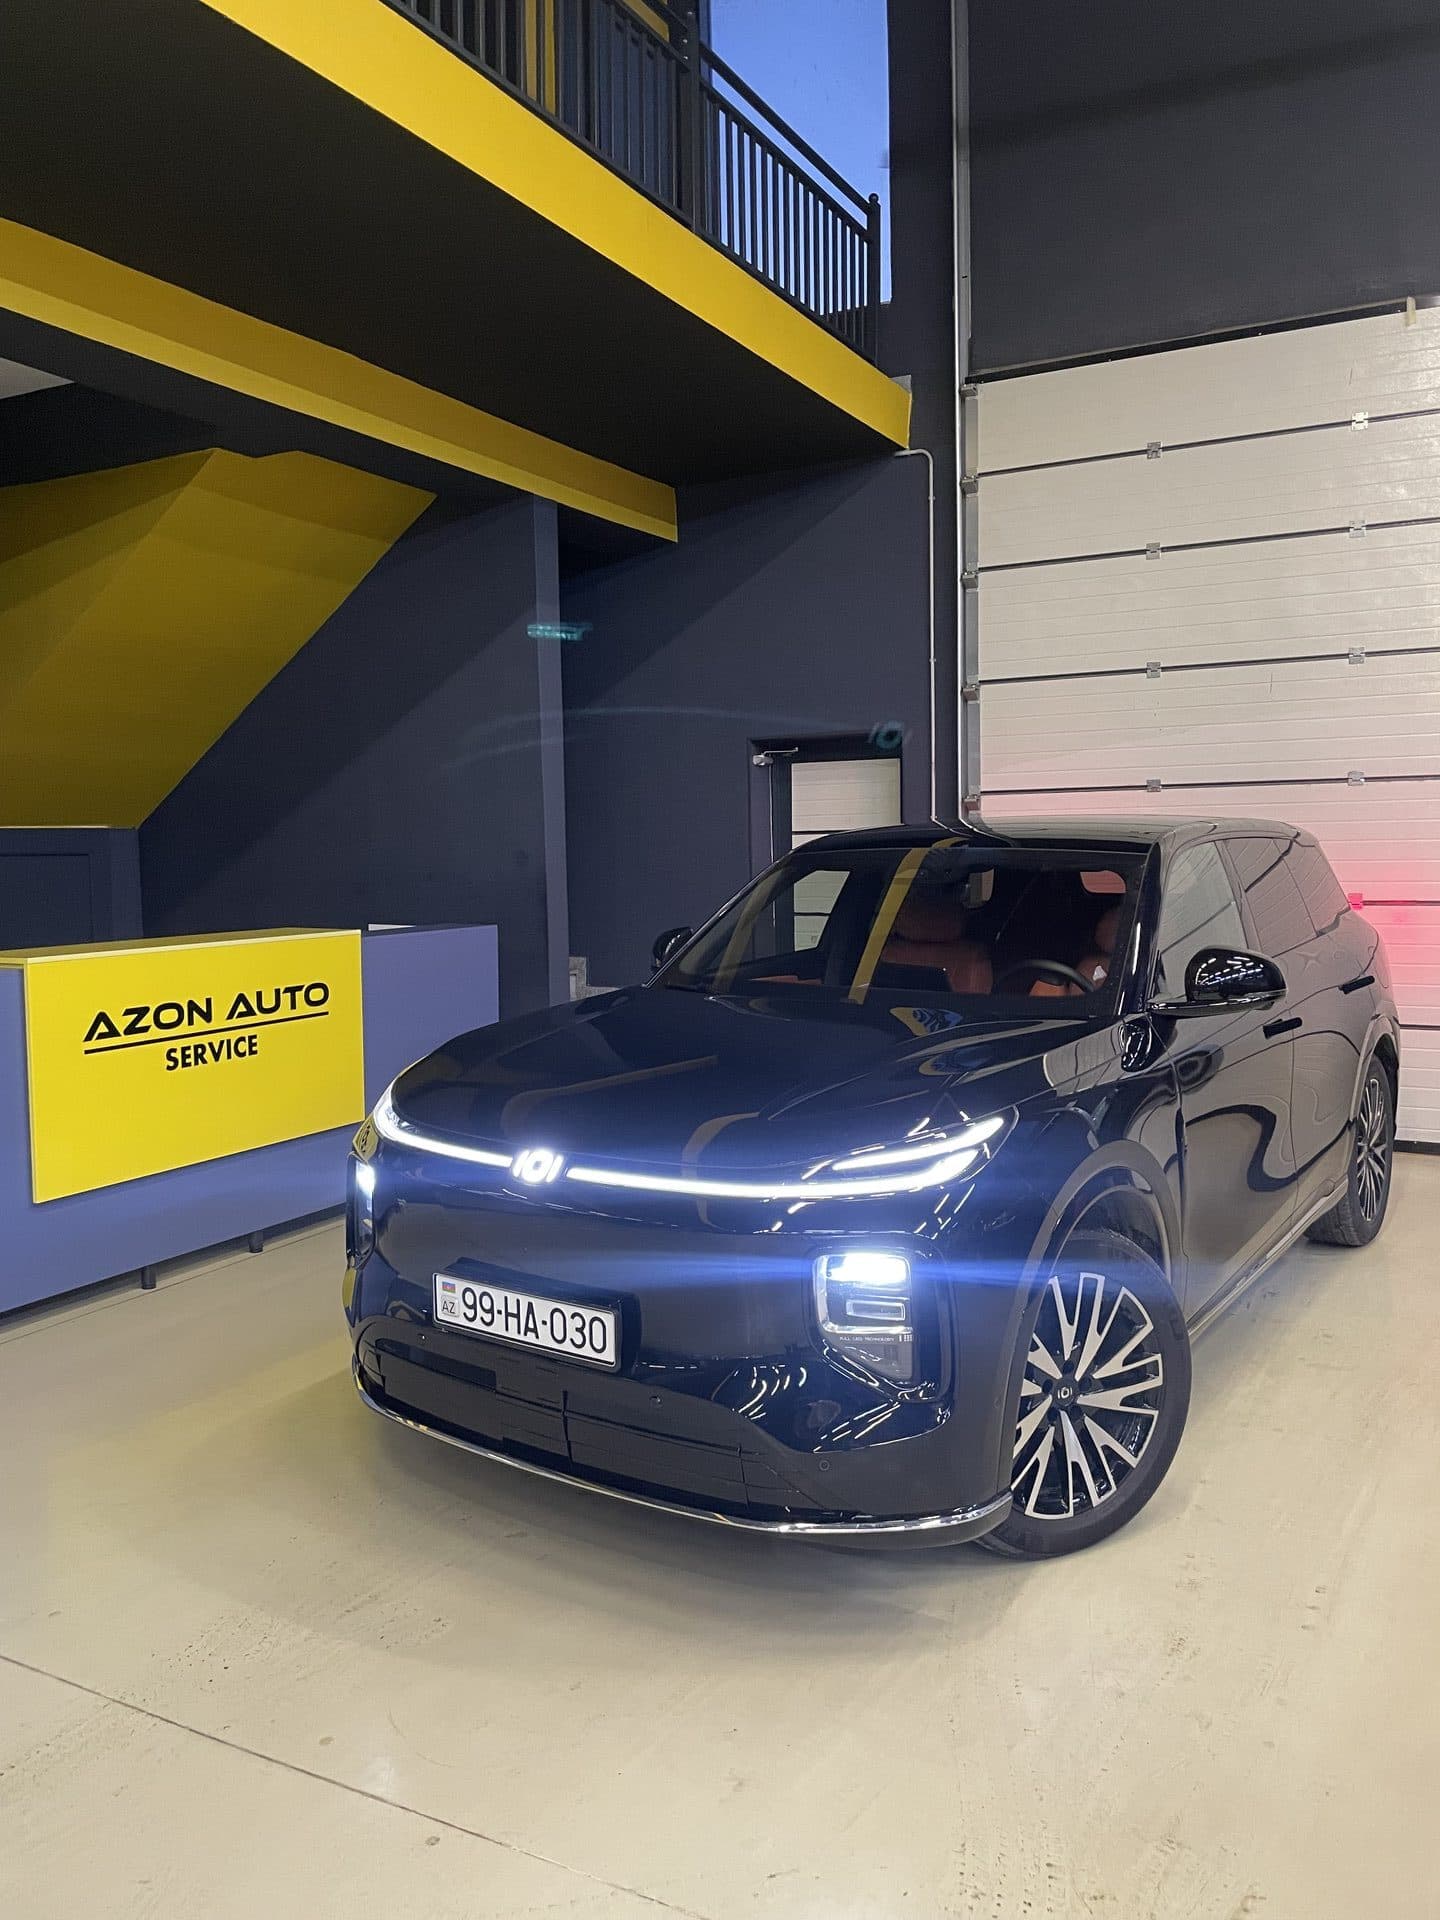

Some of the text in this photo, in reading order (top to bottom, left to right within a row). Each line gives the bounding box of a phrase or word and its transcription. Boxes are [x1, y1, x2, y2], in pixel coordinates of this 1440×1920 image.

[83, 982, 330, 1042] AZON AUTO
[165, 1034, 258, 1071] SERVICE
[441, 1300, 456, 1315] AZ
[461, 1286, 607, 1354] 99-HA-030
